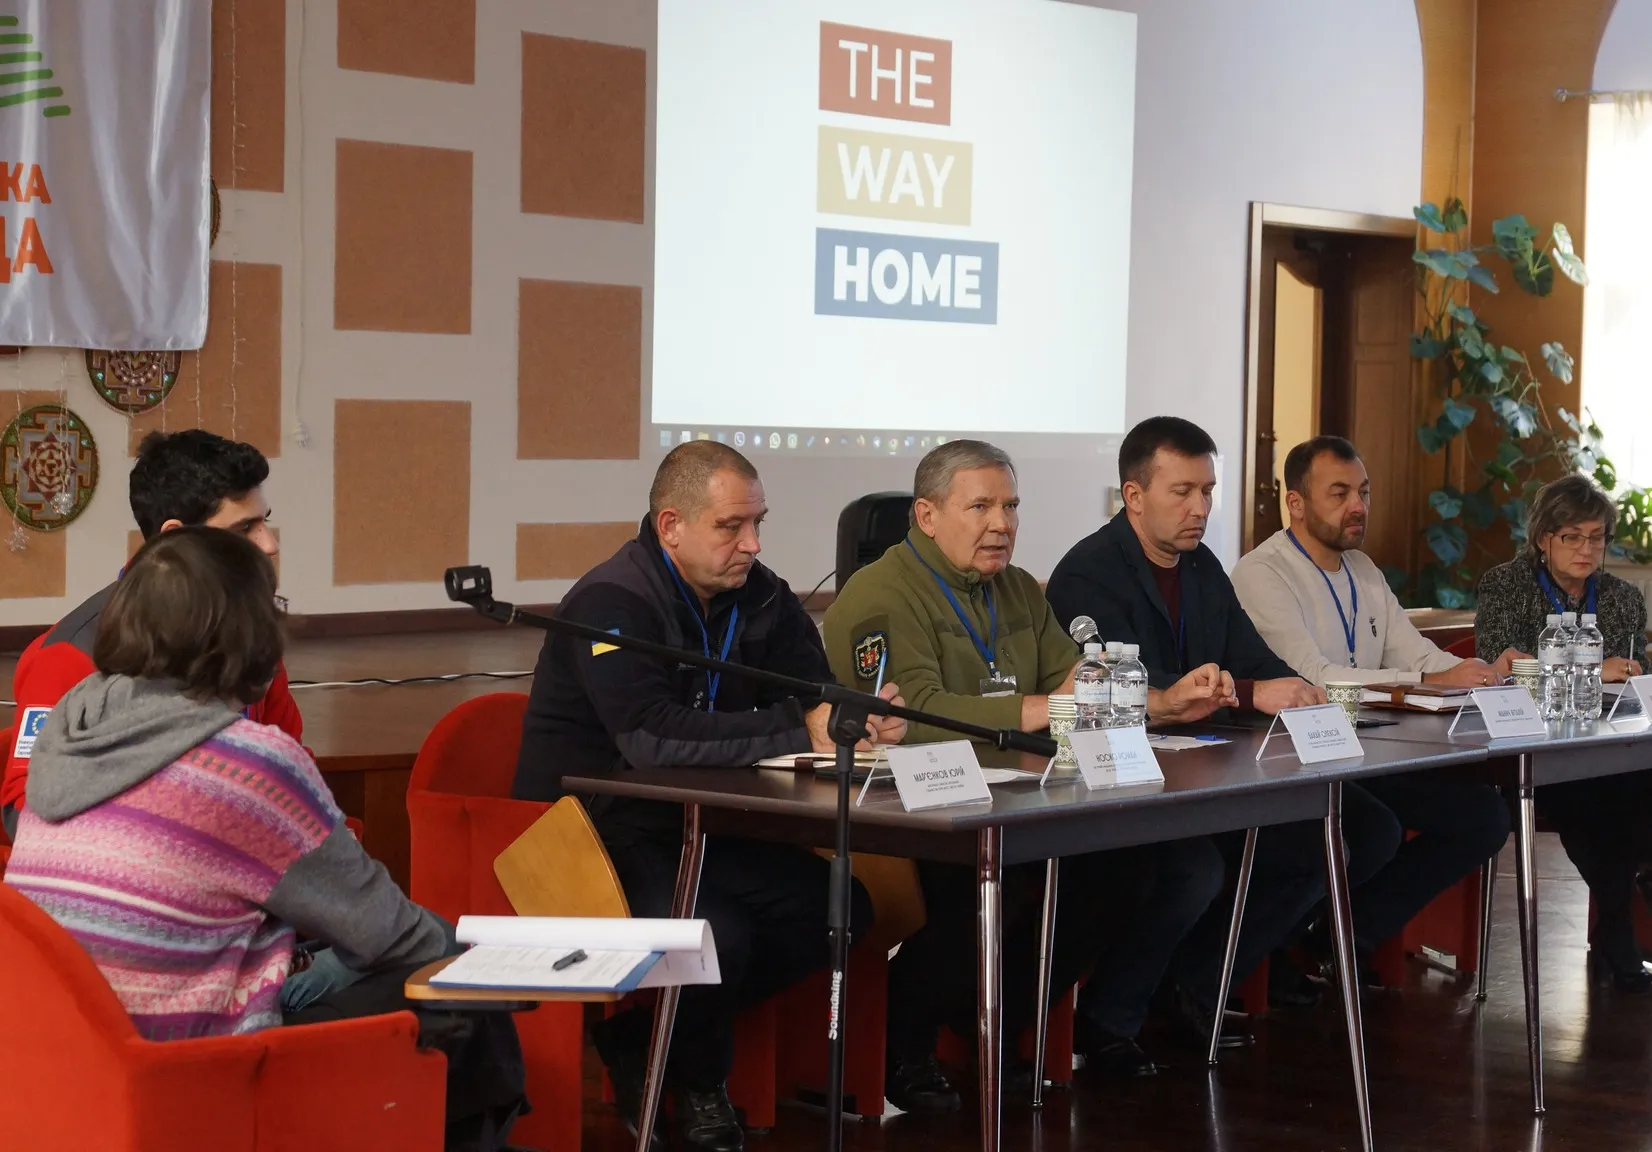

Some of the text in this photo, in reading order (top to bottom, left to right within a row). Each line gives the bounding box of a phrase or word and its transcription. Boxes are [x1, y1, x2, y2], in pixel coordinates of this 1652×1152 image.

[838, 39, 935, 109] THE
[837, 142, 955, 209] WAY
[833, 245, 982, 309] HOME
[828, 971, 843, 1040] Soundking
